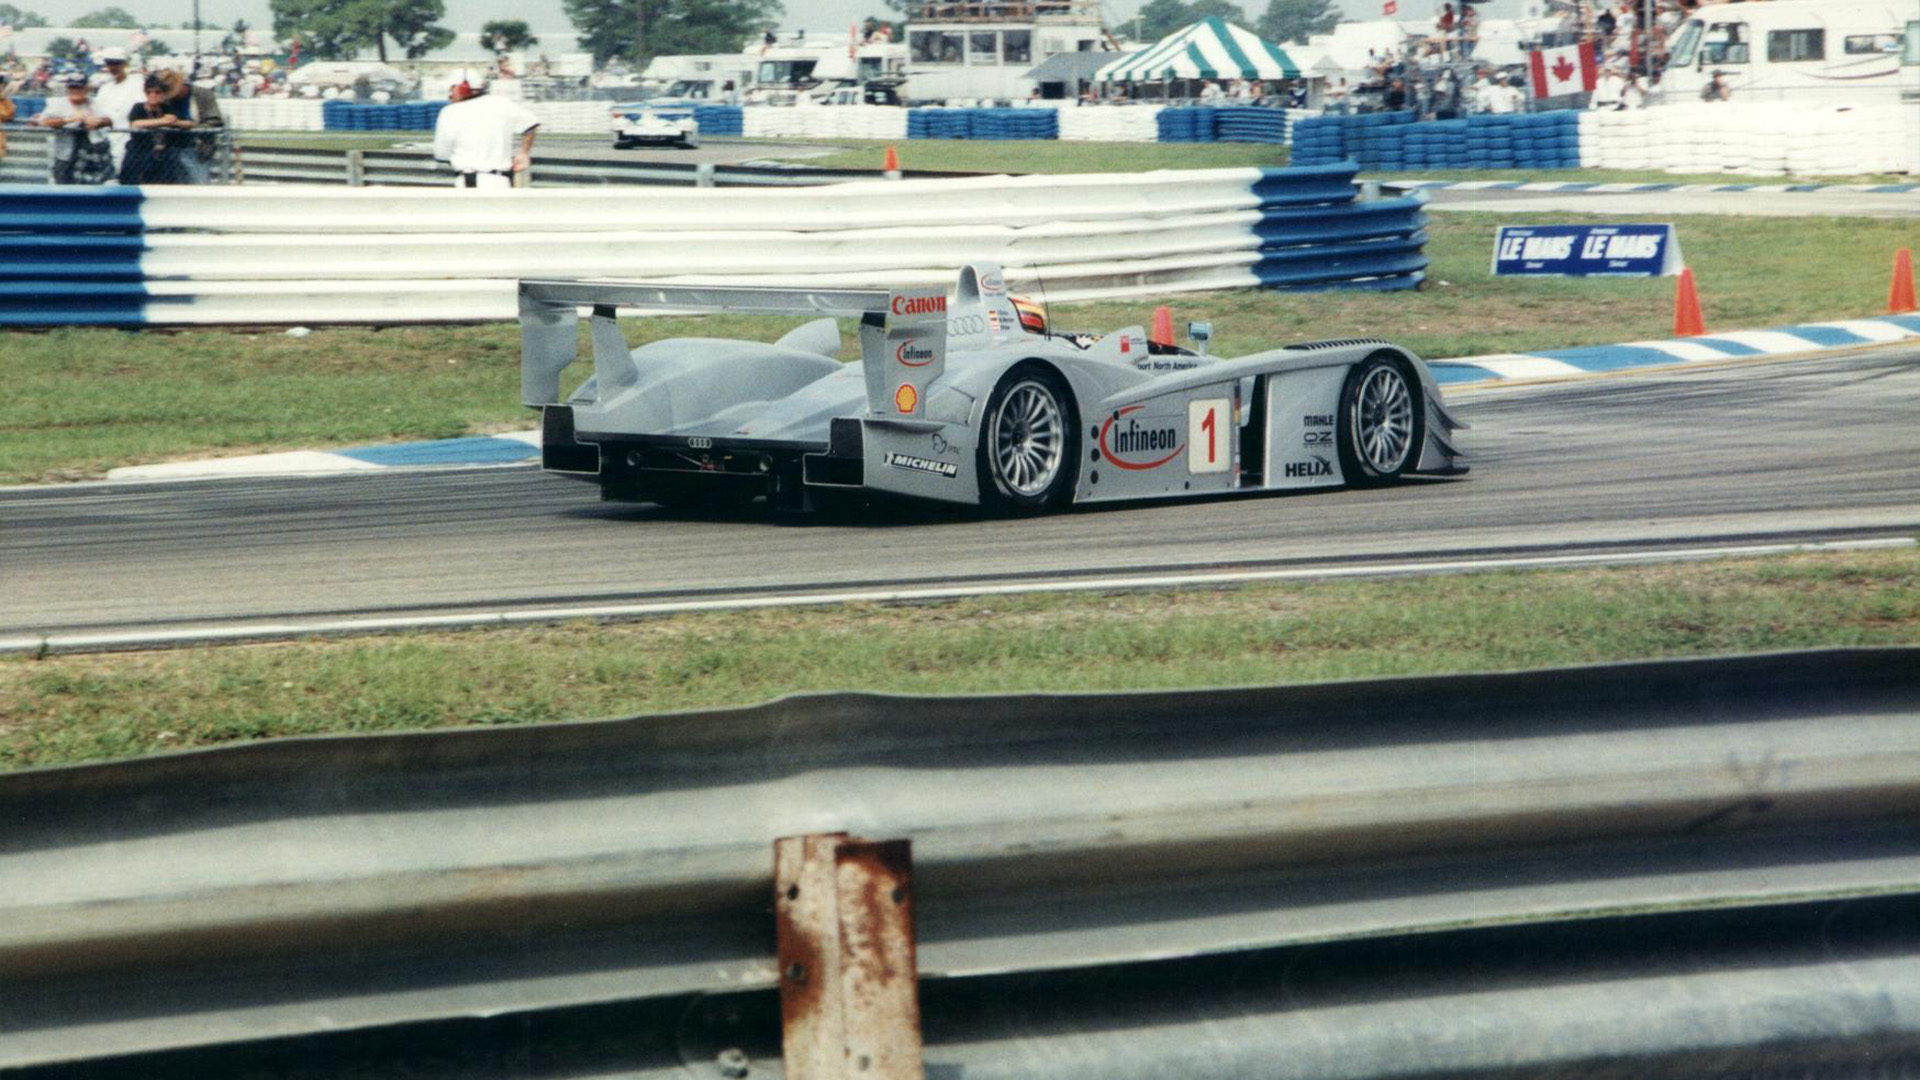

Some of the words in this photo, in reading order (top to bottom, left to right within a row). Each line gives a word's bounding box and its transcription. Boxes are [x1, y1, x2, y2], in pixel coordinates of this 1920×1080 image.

[1498, 237, 1525, 260] LE
[1580, 235, 1609, 259] LE
[891, 295, 947, 316] Canon
[1153, 361, 1172, 370] North
[1304, 415, 1334, 427] MAHLE
[1114, 418, 1176, 453] Infineon
[1202, 407, 1216, 463] 1
[894, 455, 958, 475] MICHELIN
[1285, 461, 1334, 477] HELIX
